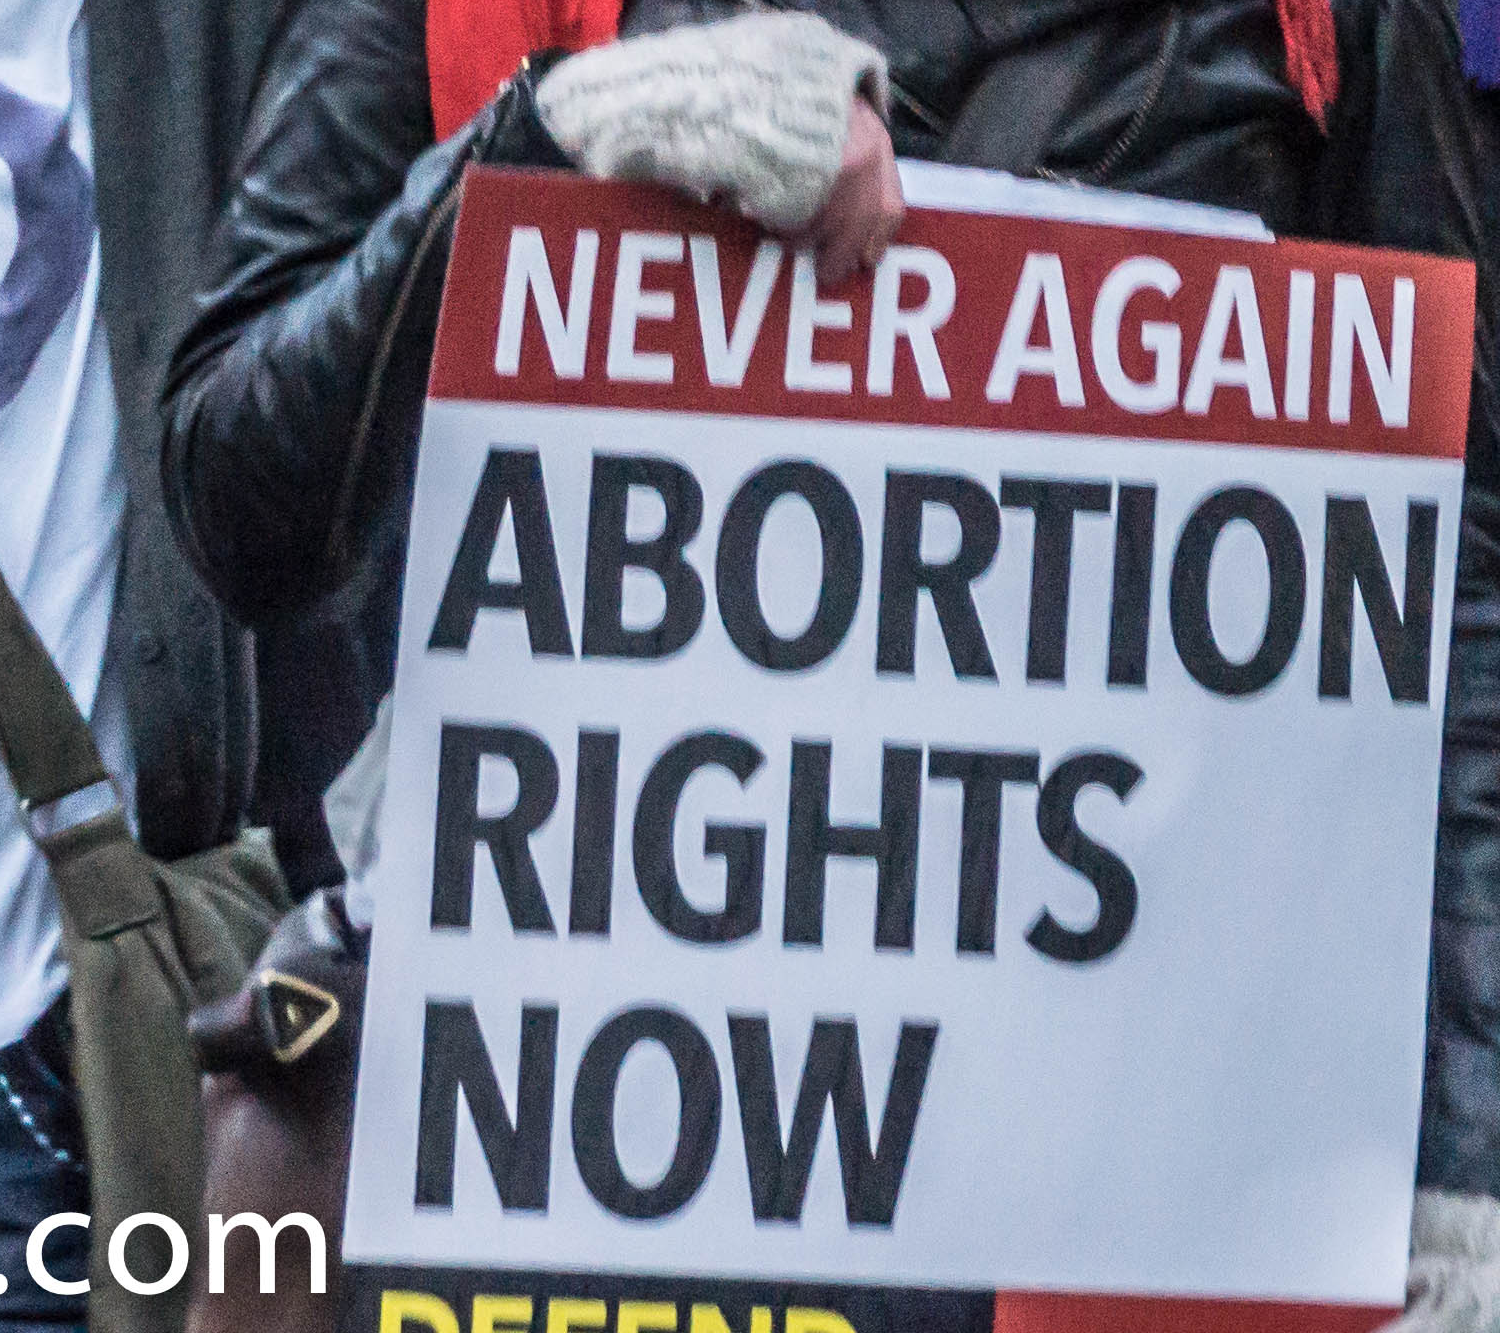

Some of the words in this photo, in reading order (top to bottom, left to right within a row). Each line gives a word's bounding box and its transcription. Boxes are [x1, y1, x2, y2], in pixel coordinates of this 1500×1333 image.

[494, 226, 954, 402] NEVER
[986, 254, 1417, 431] AGAIN
[427, 444, 1442, 706] ABORTION
[430, 719, 1145, 966] RIGHTS
[414, 999, 940, 1231] NOW
